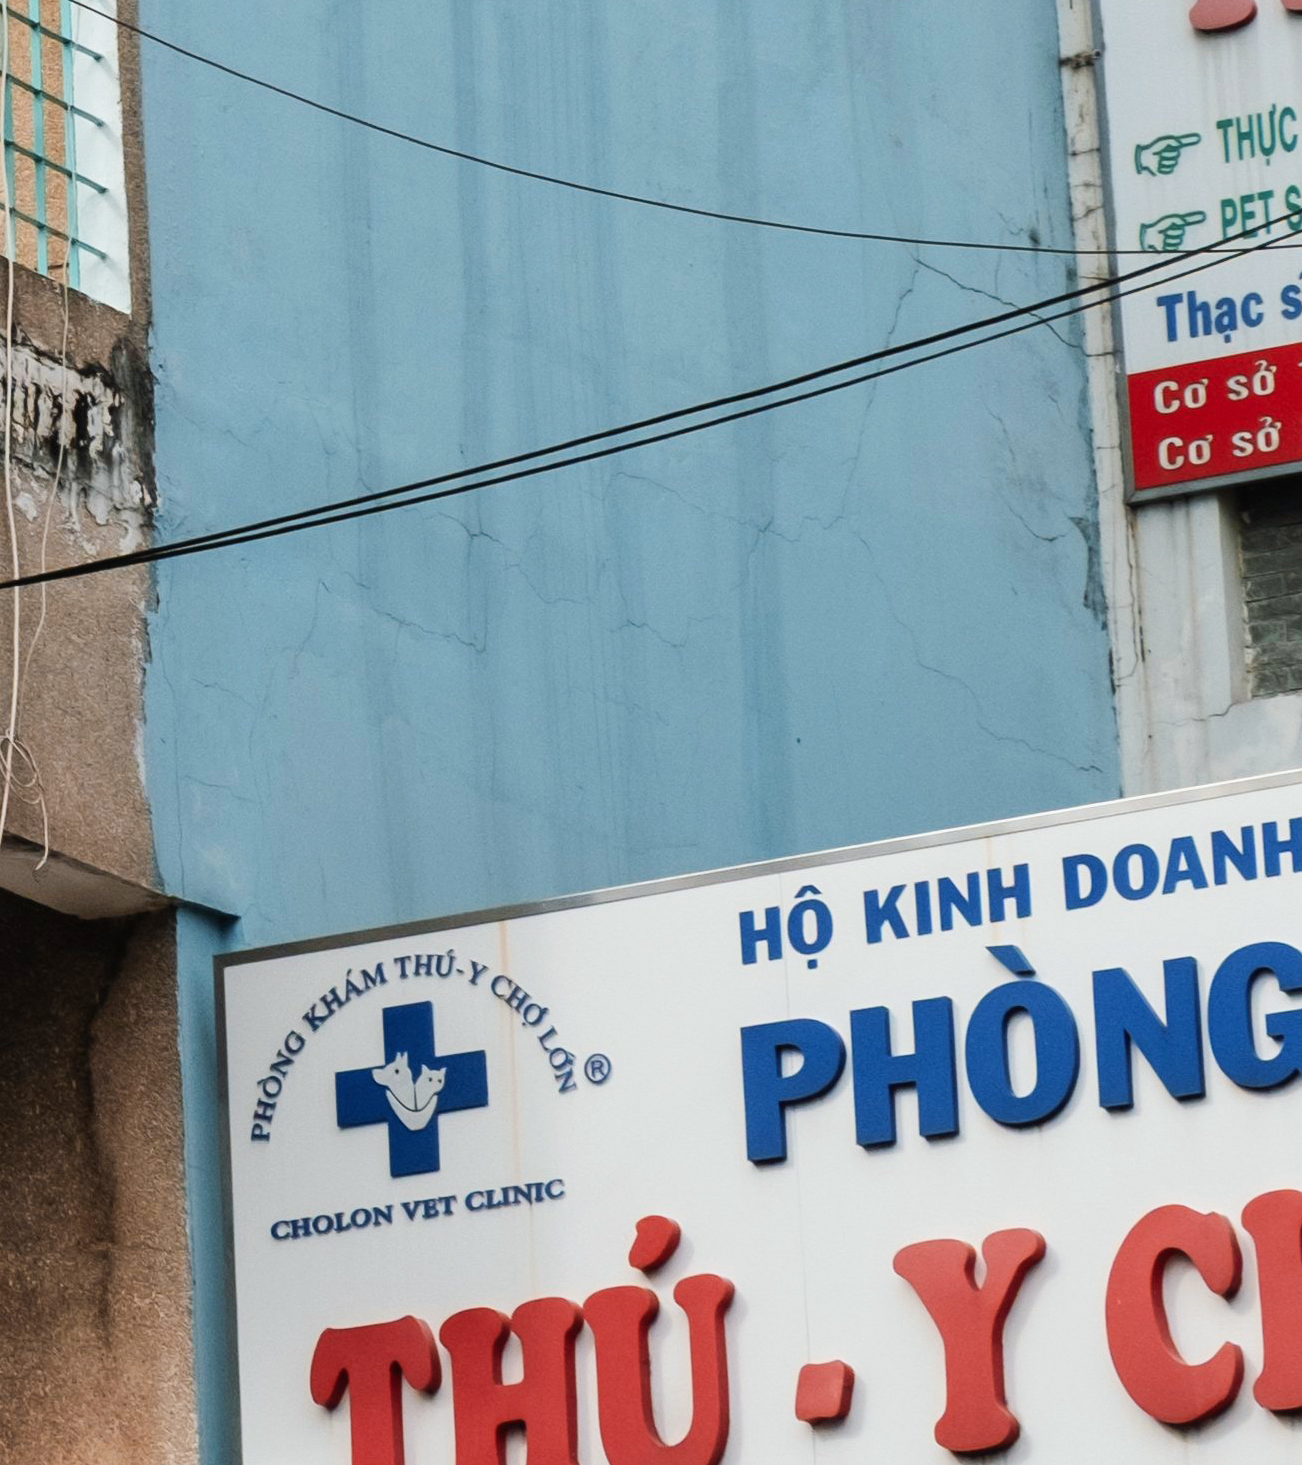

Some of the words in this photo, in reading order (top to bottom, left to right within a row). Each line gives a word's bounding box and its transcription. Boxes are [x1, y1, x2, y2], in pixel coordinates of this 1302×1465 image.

[1215, 103, 1299, 167] THỰC
[1219, 187, 1276, 246] PET
[1156, 289, 1265, 345] Thạc
[1153, 376, 1209, 415] Cơ
[1226, 358, 1278, 402] sở
[1157, 433, 1214, 472] Cơ
[1230, 415, 1283, 458] sở
[738, 883, 834, 971] HỘ
[862, 863, 1033, 946] KINH
[1061, 816, 1302, 913] DOANH
[250, 1029, 307, 1143] PHÒNG
[301, 961, 389, 1034] KHÁM
[489, 973, 551, 1029] CHỢ
[537, 1025, 579, 1097] LỚN
[740, 940, 1302, 1167] PHÒNG
[269, 1204, 395, 1243] CHOLON
[400, 1194, 457, 1221] VET
[464, 1177, 567, 1213] CLINIC
[891, 1226, 1048, 1456] Y
